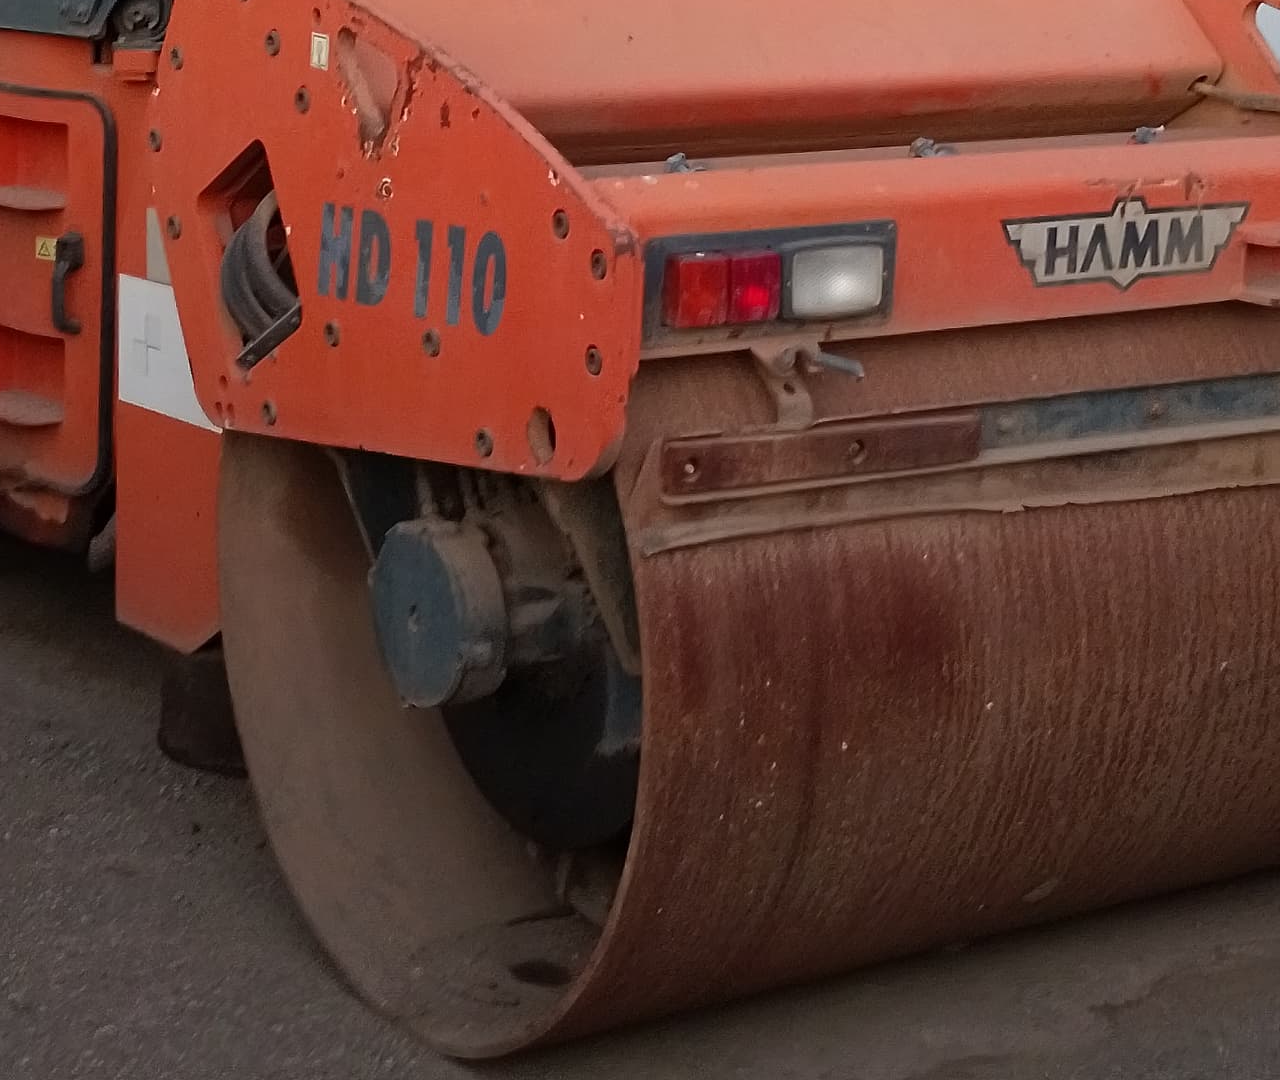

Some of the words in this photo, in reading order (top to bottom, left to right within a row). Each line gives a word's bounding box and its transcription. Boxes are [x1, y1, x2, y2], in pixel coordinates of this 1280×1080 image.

[317, 202, 391, 306] HD
[413, 219, 507, 337] 110
[1044, 215, 1204, 276] HAMM
